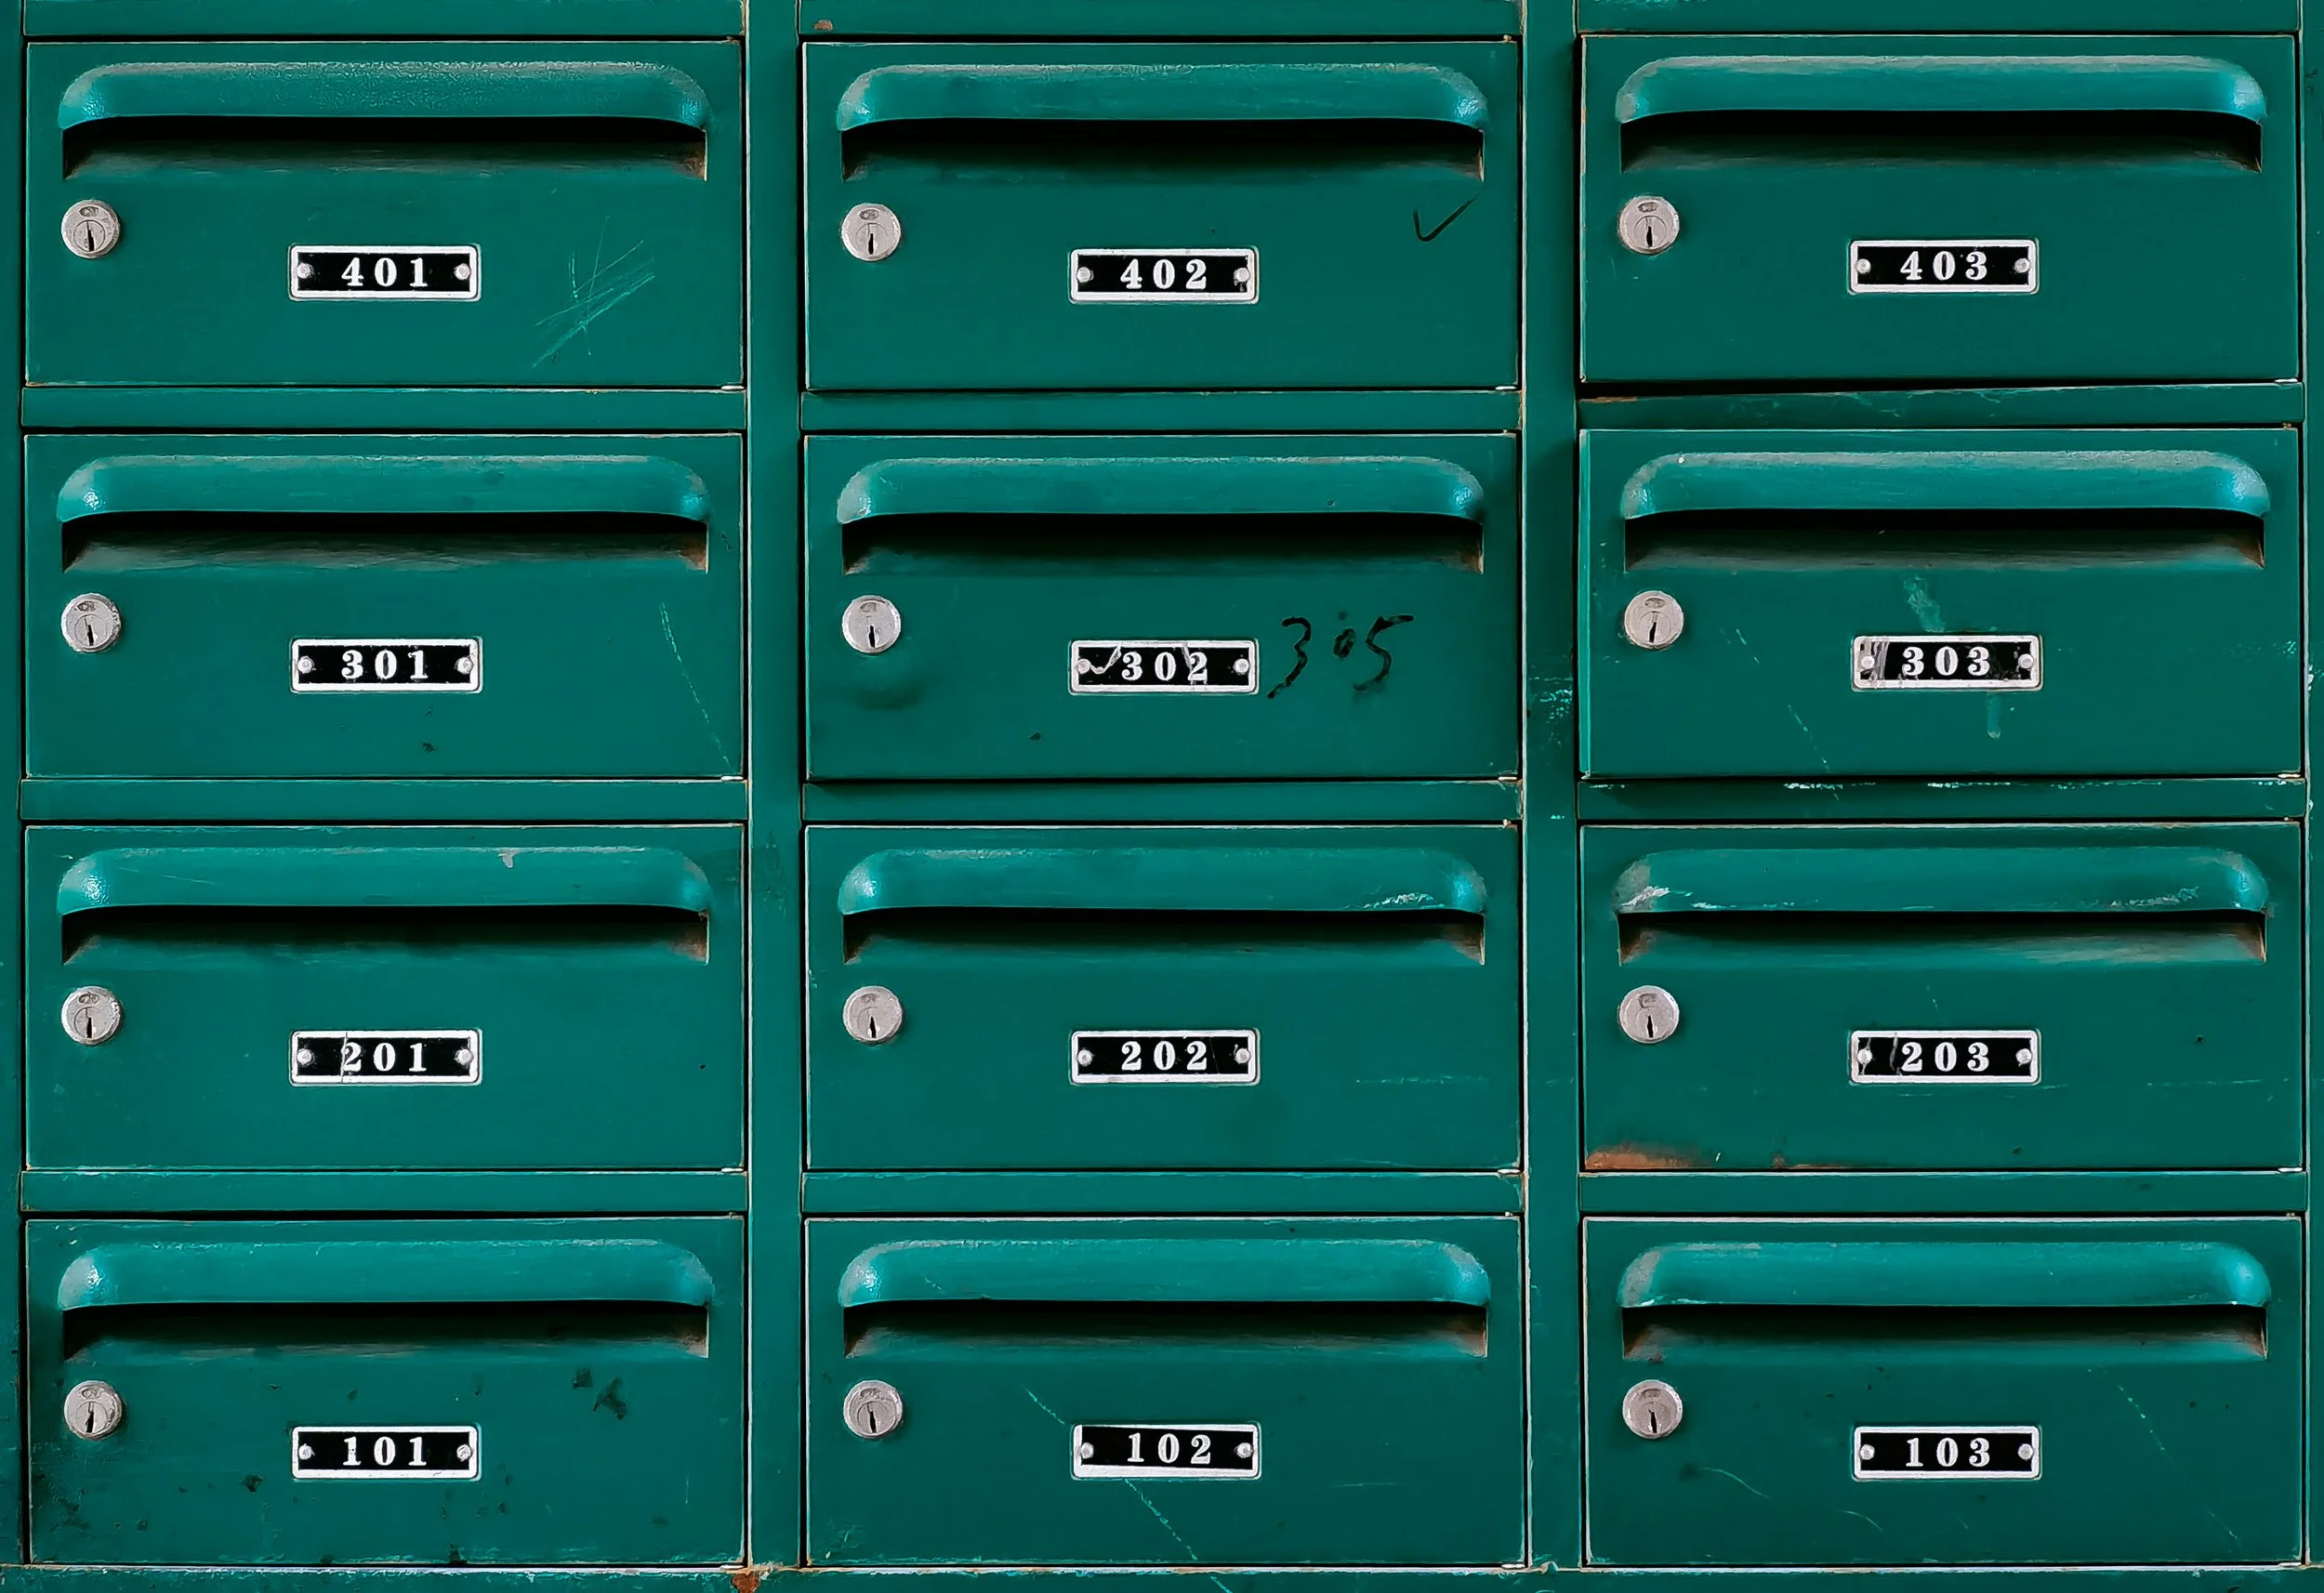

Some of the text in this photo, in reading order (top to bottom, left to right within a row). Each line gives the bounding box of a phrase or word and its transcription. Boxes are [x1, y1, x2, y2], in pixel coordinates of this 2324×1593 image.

[340, 257, 429, 287] 401
[1119, 258, 1207, 290] 402
[1899, 250, 1987, 281] 403
[341, 649, 429, 680] 301
[1121, 651, 1208, 682] 302
[1267, 614, 1415, 699] 305
[1902, 645, 1990, 677] 303
[341, 1042, 428, 1073] 201
[1121, 1040, 1208, 1071] 202
[1900, 1041, 1989, 1073] 203
[342, 1436, 428, 1467] 101
[1127, 1432, 1211, 1465] 102
[1905, 1437, 1990, 1468] 103
